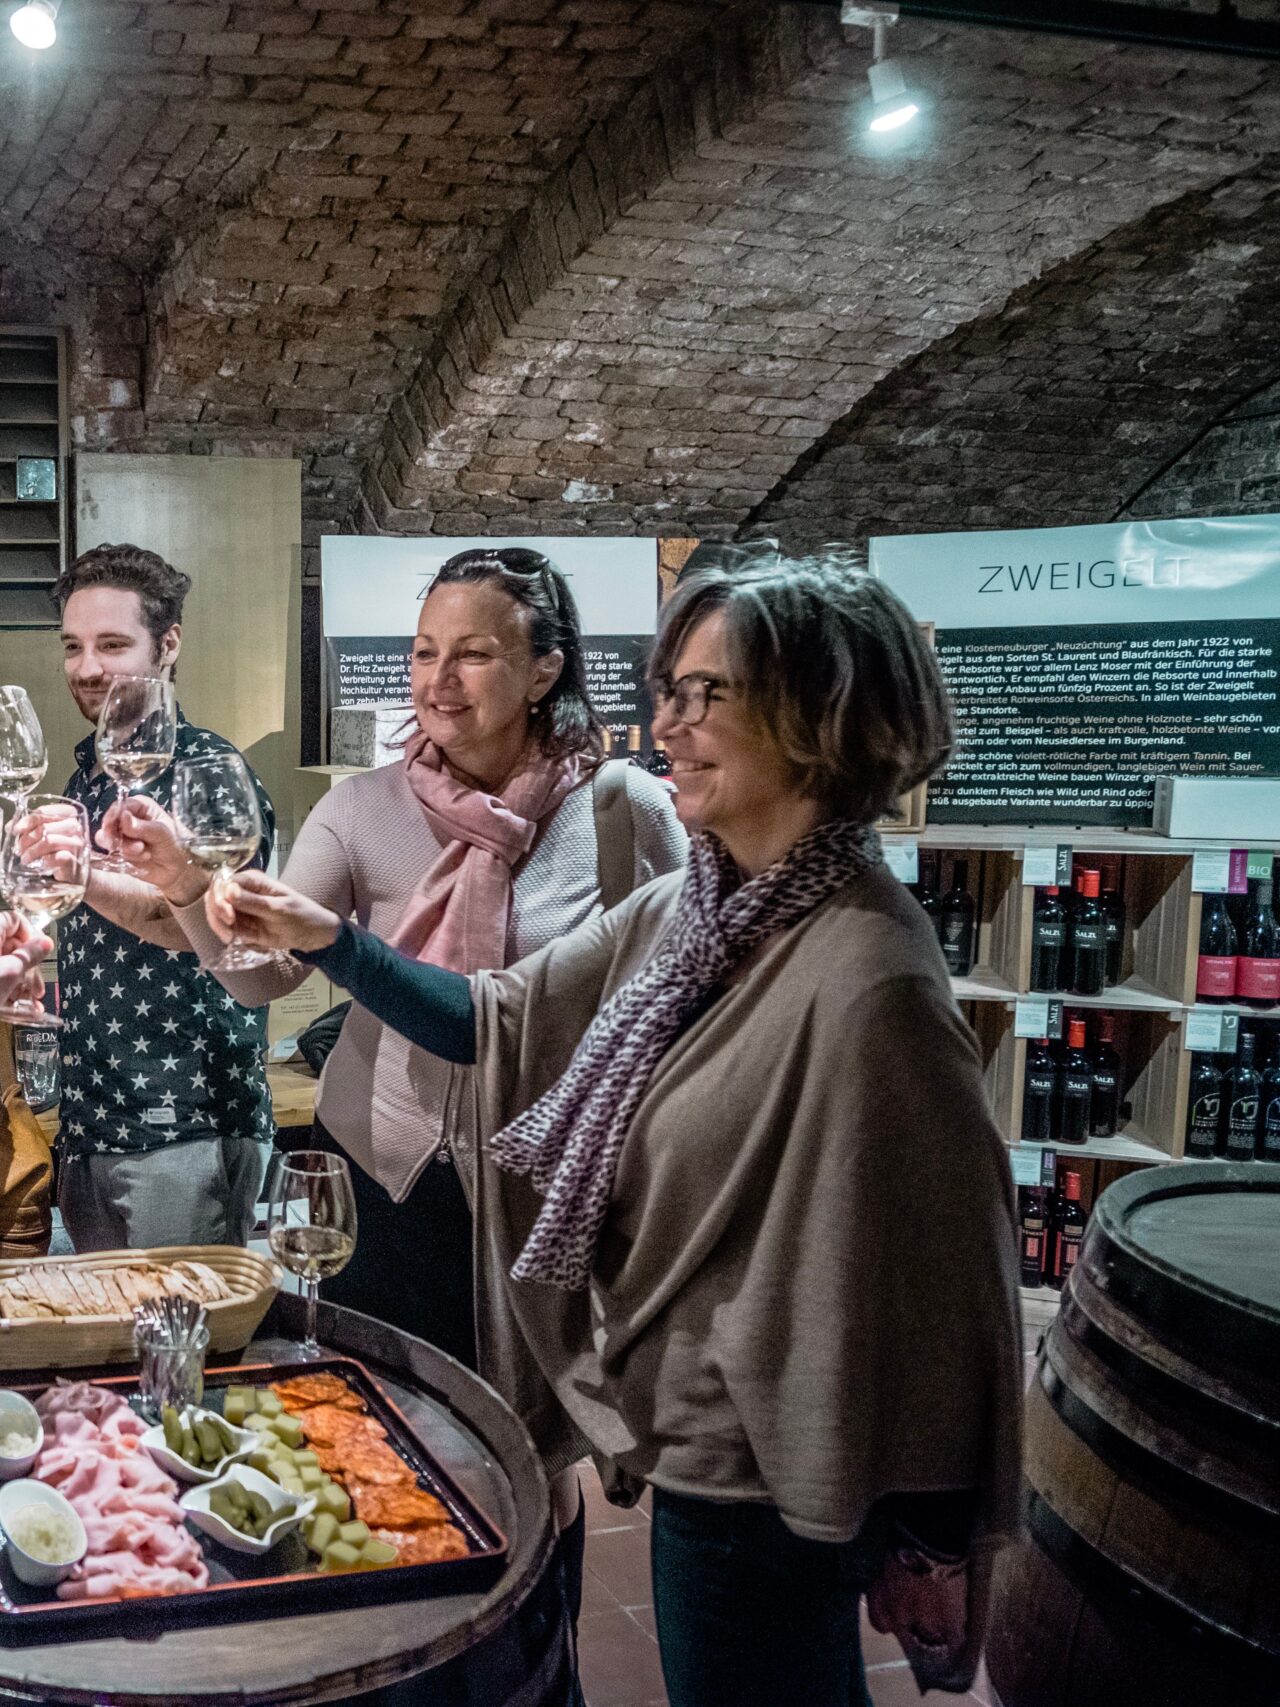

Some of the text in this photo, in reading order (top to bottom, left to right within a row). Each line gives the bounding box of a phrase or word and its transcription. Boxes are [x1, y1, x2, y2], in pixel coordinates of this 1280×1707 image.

[978, 556, 1191, 593] ZWEIGELT
[941, 645, 962, 654] eine
[964, 642, 1049, 655] Klosterneuburger
[1152, 639, 1176, 648] dem
[1177, 638, 1200, 647] Jahr
[1202, 637, 1229, 646] 1922
[1232, 638, 1253, 646] von
[340, 654, 373, 663] Zweigelt
[584, 652, 602, 660] 1922
[985, 653, 1004, 662] den
[1006, 652, 1038, 661] Sorten
[1041, 652, 1055, 661] St.
[1057, 651, 1096, 660] Laurent
[1098, 650, 1119, 659] und
[1121, 649, 1194, 659] Blaufränkisch.
[1218, 648, 1235, 657] die
[1237, 647, 1272, 656] starke
[372, 665, 405, 674] Zweigelt
[595, 662, 632, 670] die starke
[940, 665, 956, 673] der
[958, 664, 1002, 673] Rebsorte
[1043, 662, 1072, 671] allem
[1073, 662, 1098, 671] Lenz
[1100, 661, 1131, 670] Moser
[1134, 661, 1152, 670] mit
[1154, 660, 1172, 669] der
[1174, 659, 1234, 670] Einführung
[1236, 659, 1255, 667] der
[340, 676, 385, 685] Verbreitung
[608, 672, 621, 680] der
[1010, 669, 1277, 684] Er empfahl den Winzern die Rebsorte und innerhalb
[340, 686, 382, 694] Hochkultur
[601, 682, 636, 690] innerhalb
[960, 685, 984, 696] stieg
[986, 685, 1004, 694] der
[1005, 684, 1036, 693] Anbau
[1057, 684, 1092, 694] fünfzig
[1094, 683, 1132, 692] Prozent
[1154, 682, 1168, 691] So
[1170, 682, 1184, 691] ist
[1186, 682, 1205, 691] der
[1207, 681, 1254, 692] Zweigelt
[588, 693, 621, 702] Zweigelt
[1010, 694, 1074, 704] Rotweinsorte
[1140, 693, 1151, 701] In
[1153, 692, 1180, 701] allen
[1182, 691, 1276, 702] Weinbaugebieten
[970, 705, 1020, 714] Standorte.
[982, 714, 1262, 726] angenehm fruchtige Weine ohne Holznote sehr schön
[1004, 726, 1043, 736] Beispiel
[1053, 726, 1068, 734] als
[1070, 725, 1095, 734] auch
[1098, 725, 1149, 736] kraftvolle,
[1151, 725, 1214, 734] holzbetonte
[1217, 725, 1251, 733] Weine
[986, 736, 1008, 744] oder
[1034, 736, 1105, 744] Neusiedlersee
[1108, 736, 1121, 744] im
[1123, 736, 1186, 746] Burgenland.
[955, 751, 976, 759] eine
[978, 751, 1013, 759] schöne
[1089, 751, 1118, 759] Farbe
[1120, 751, 1137, 760] mit
[1140, 751, 1190, 761] kräftigem
[1193, 751, 1231, 760] Tannin.
[1233, 751, 1251, 760] Bei
[997, 762, 1018, 770] sich
[1179, 762, 1205, 771] Wein
[1208, 762, 1226, 771] mit
[946, 772, 968, 780] Sehr
[970, 772, 1035, 781] extraktreiche
[1037, 772, 1068, 781] Weine
[1070, 772, 1102, 781] bauen
[1104, 772, 1140, 781] Winzer
[956, 786, 1152, 796] dunklem Fleisch wie Wild und Rind oder
[932, 796, 950, 805] süß
[952, 796, 1008, 807] ausgebaute
[1010, 797, 1050, 806] Variante
[1052, 797, 1108, 806] wunderbar
[1248, 866, 1271, 876] BIO
[1040, 928, 1060, 936] SALZL
[1075, 930, 1096, 938] SALZL
[1030, 1079, 1051, 1087] SALZL
[1094, 1074, 1114, 1083] SALZL
[1068, 1081, 1088, 1089] SALZL
